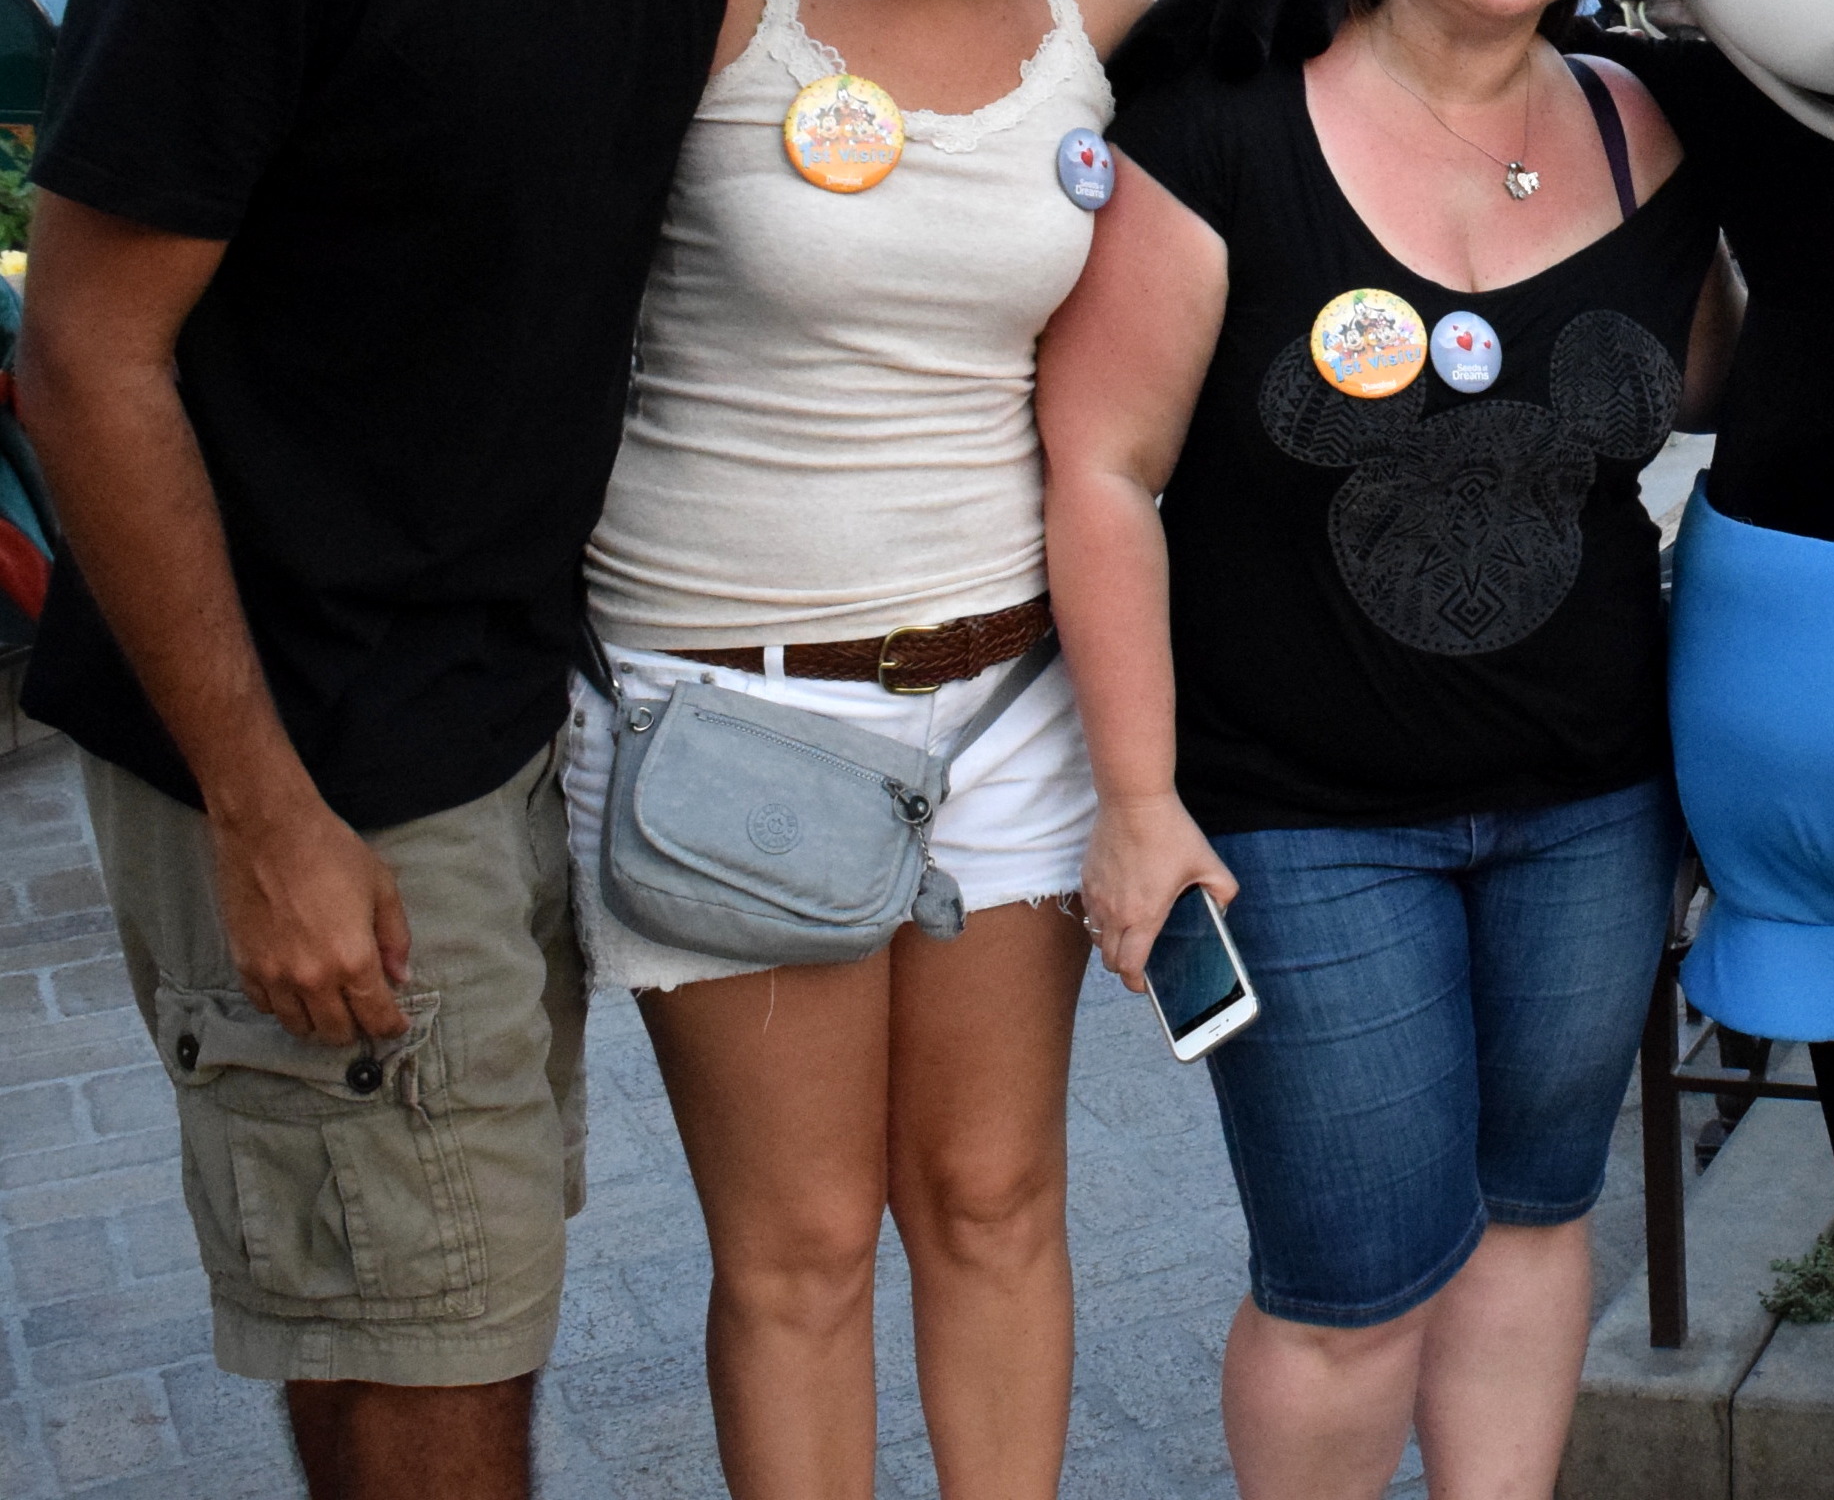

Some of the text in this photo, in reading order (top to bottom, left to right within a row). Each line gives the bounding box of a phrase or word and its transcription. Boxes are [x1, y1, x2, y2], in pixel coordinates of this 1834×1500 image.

[800, 142, 830, 169] 1st
[1330, 348, 1421, 383] 1st Visit!
[1452, 370, 1489, 380] Dreams
